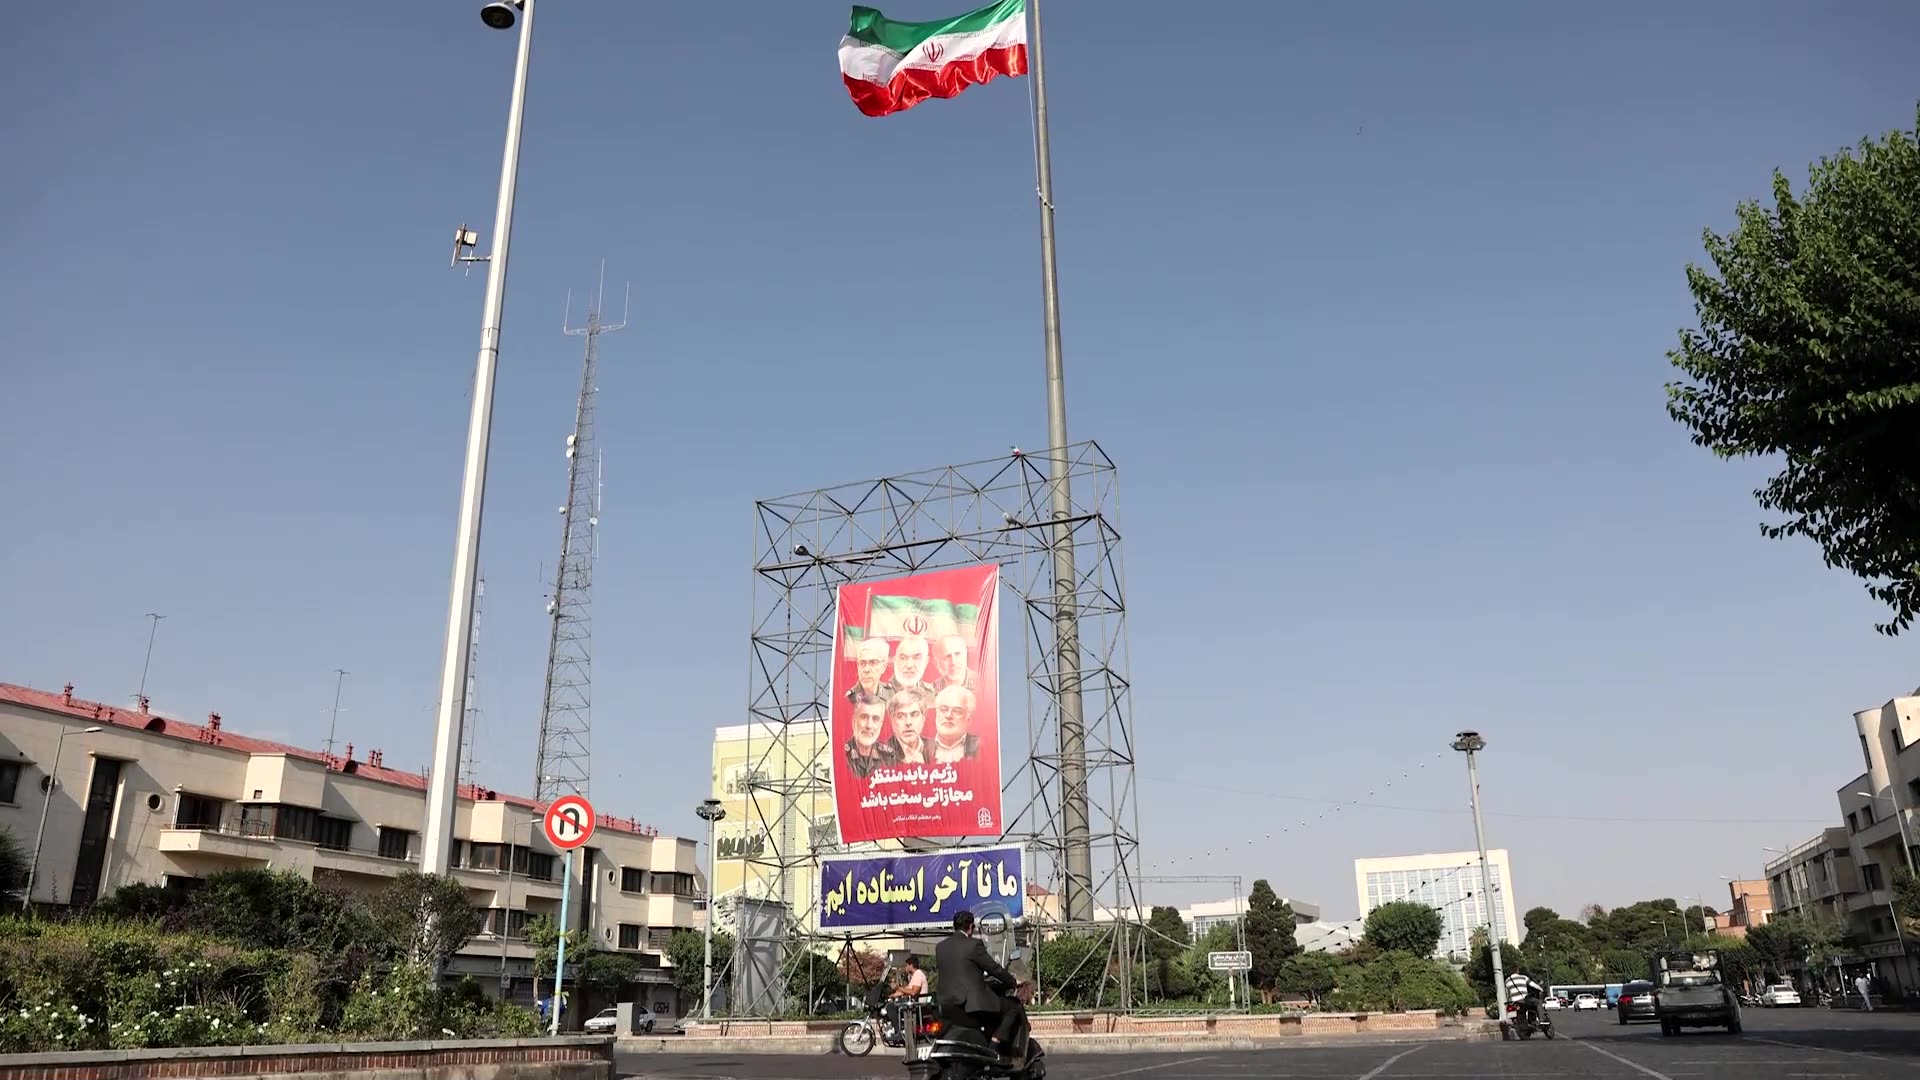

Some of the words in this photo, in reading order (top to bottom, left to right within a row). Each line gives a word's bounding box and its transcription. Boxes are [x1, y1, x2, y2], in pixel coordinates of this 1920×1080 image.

[869, 768, 903, 789] منتظر
[904, 765, 929, 785] باید
[930, 762, 958, 784] رژیم
[861, 791, 888, 810] باشد
[888, 789, 922, 805] سخت
[922, 787, 974, 808] مجازاتی
[856, 865, 925, 912] ایستاده
[929, 860, 973, 913] آخر
[976, 862, 992, 898] تا
[996, 860, 1018, 897] ما
[826, 870, 852, 919] ایم
